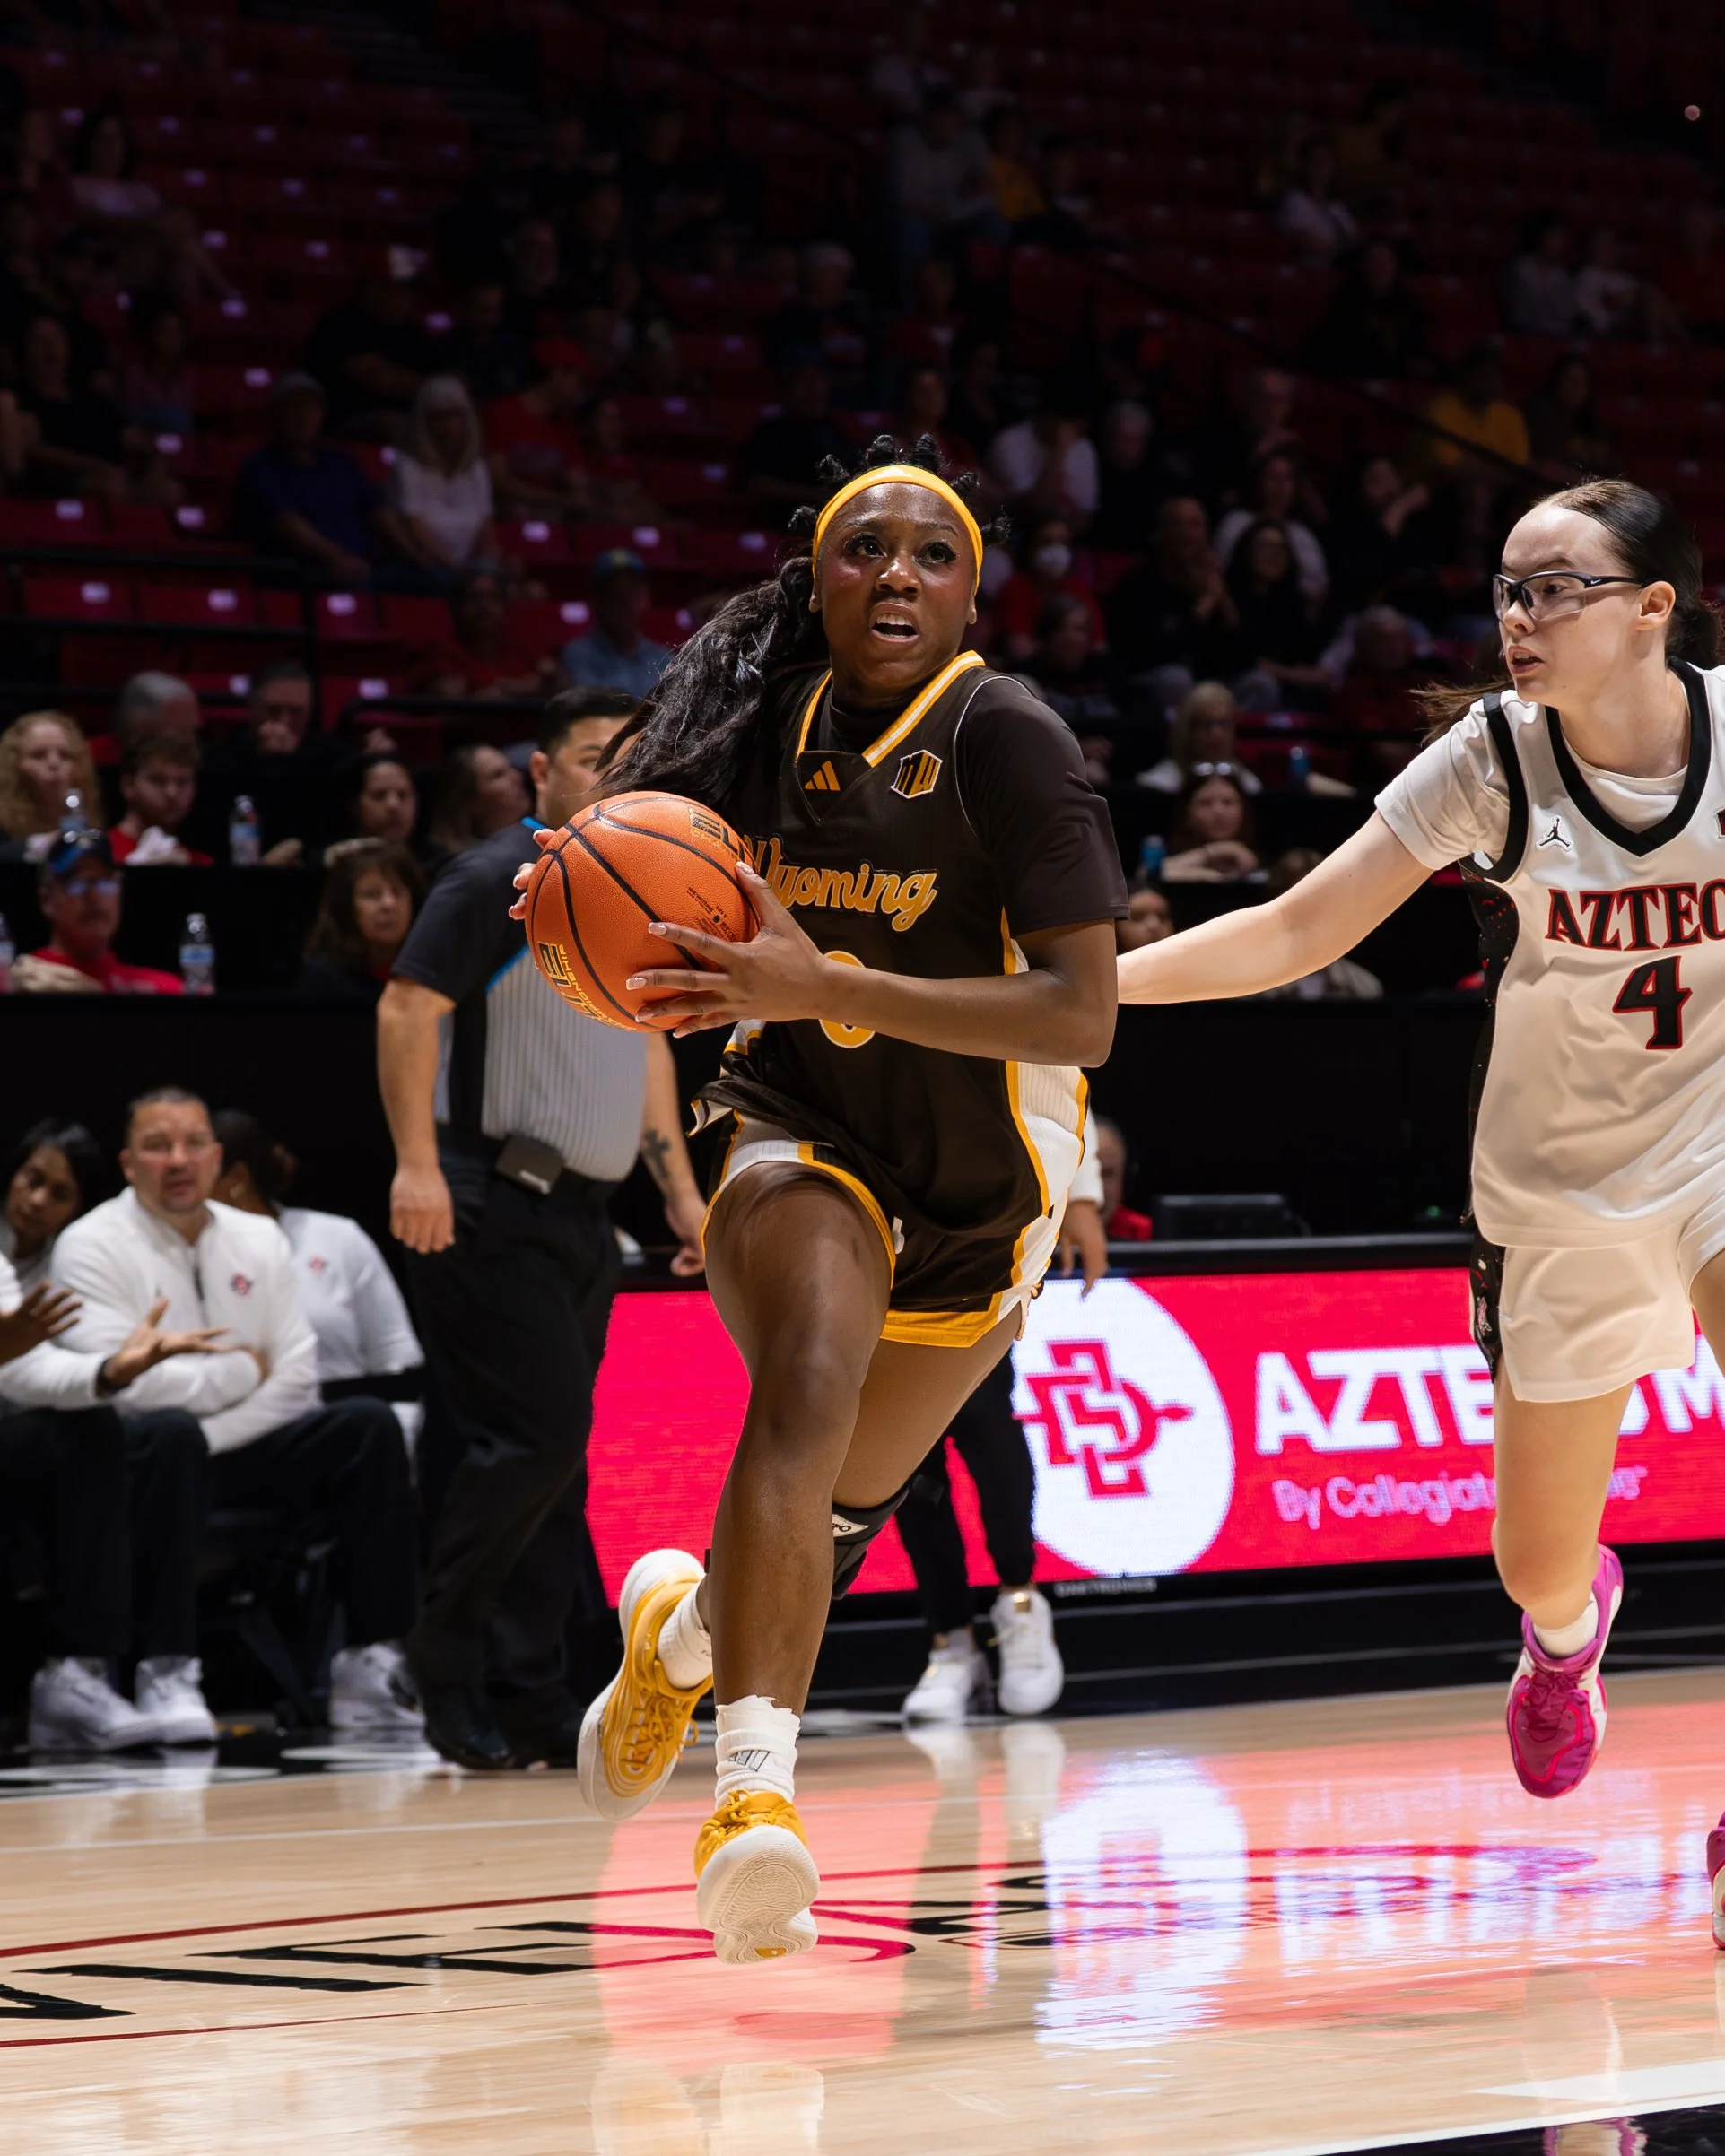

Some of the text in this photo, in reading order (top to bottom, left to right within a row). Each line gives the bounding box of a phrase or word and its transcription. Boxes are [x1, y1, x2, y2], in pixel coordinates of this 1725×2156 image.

[744, 834, 938, 932] Wyoming
[1612, 955, 1693, 1050] 4
[1271, 1470, 1496, 1530] By Collegiat
